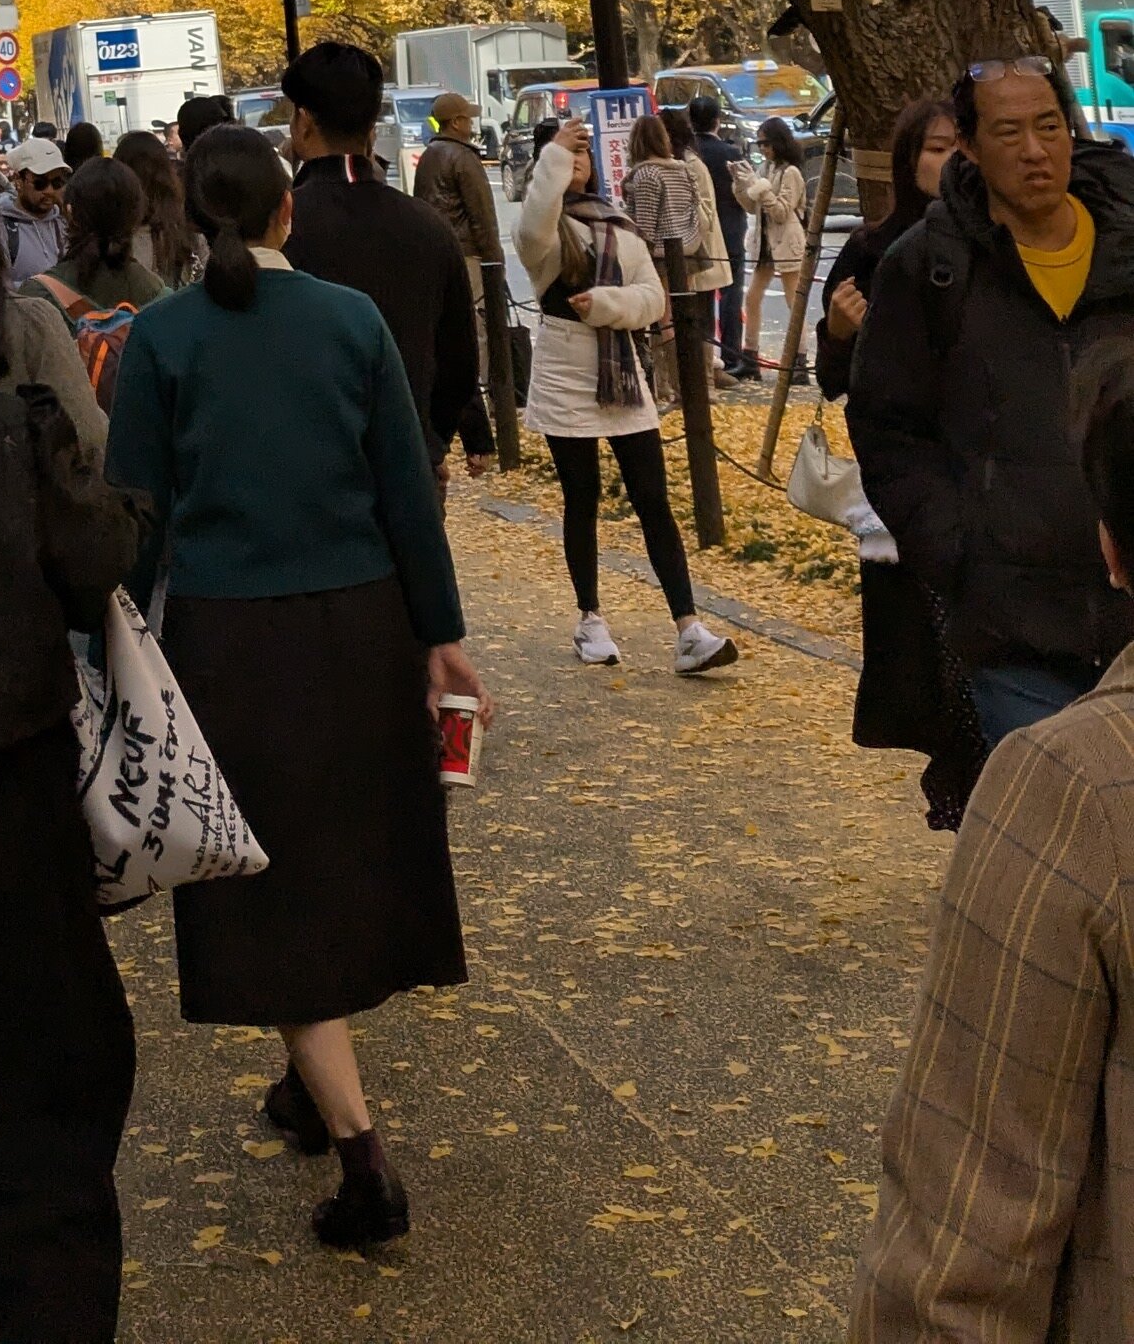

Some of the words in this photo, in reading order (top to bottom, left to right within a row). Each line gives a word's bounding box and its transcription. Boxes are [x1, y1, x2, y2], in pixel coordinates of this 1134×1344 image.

[0, 41, 14, 56] 40
[98, 42, 138, 60] 0123
[187, 27, 207, 71] VAN
[606, 96, 640, 120] FIT
[109, 700, 156, 827] NEUF
